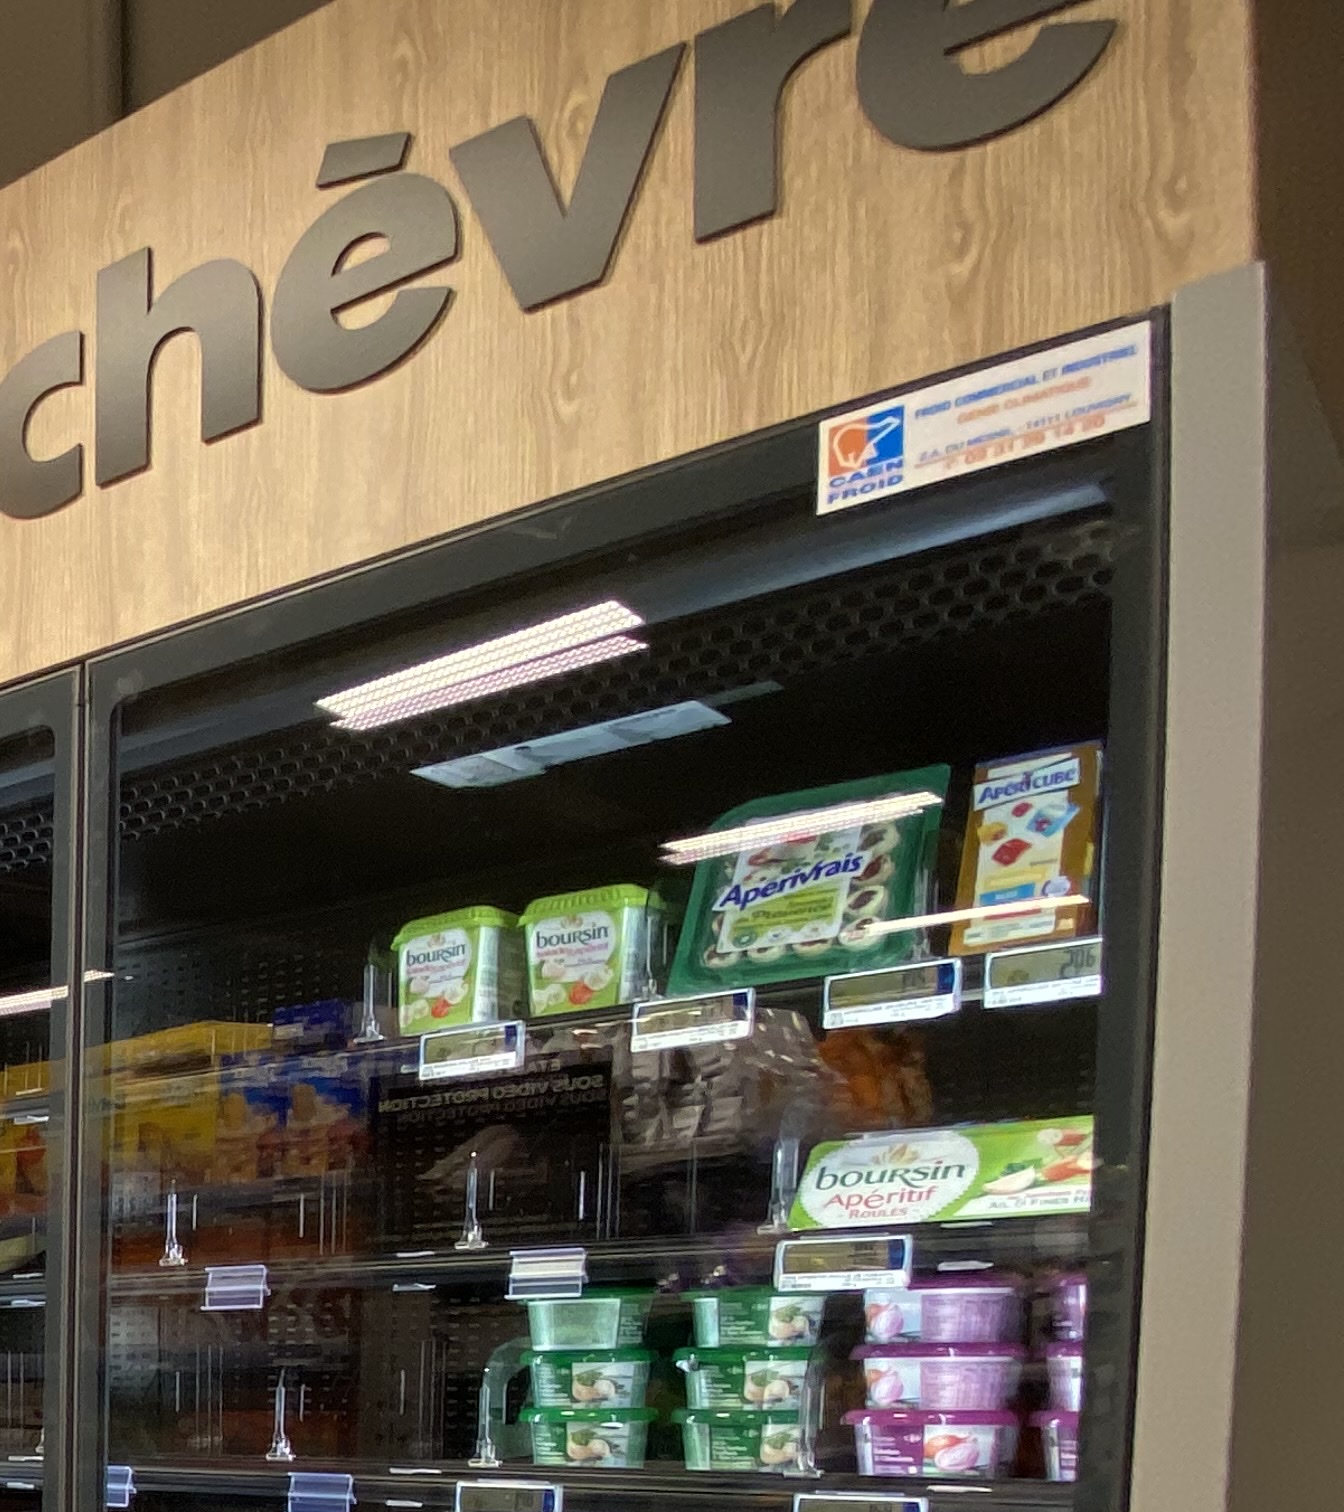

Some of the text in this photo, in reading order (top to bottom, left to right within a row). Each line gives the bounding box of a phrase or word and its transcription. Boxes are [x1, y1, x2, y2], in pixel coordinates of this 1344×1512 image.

[828, 458, 904, 489] CAEN
[826, 473, 904, 506] FROID
[535, 924, 609, 949] boursin
[405, 942, 466, 968] boursin
[815, 1159, 966, 1190] boursin
